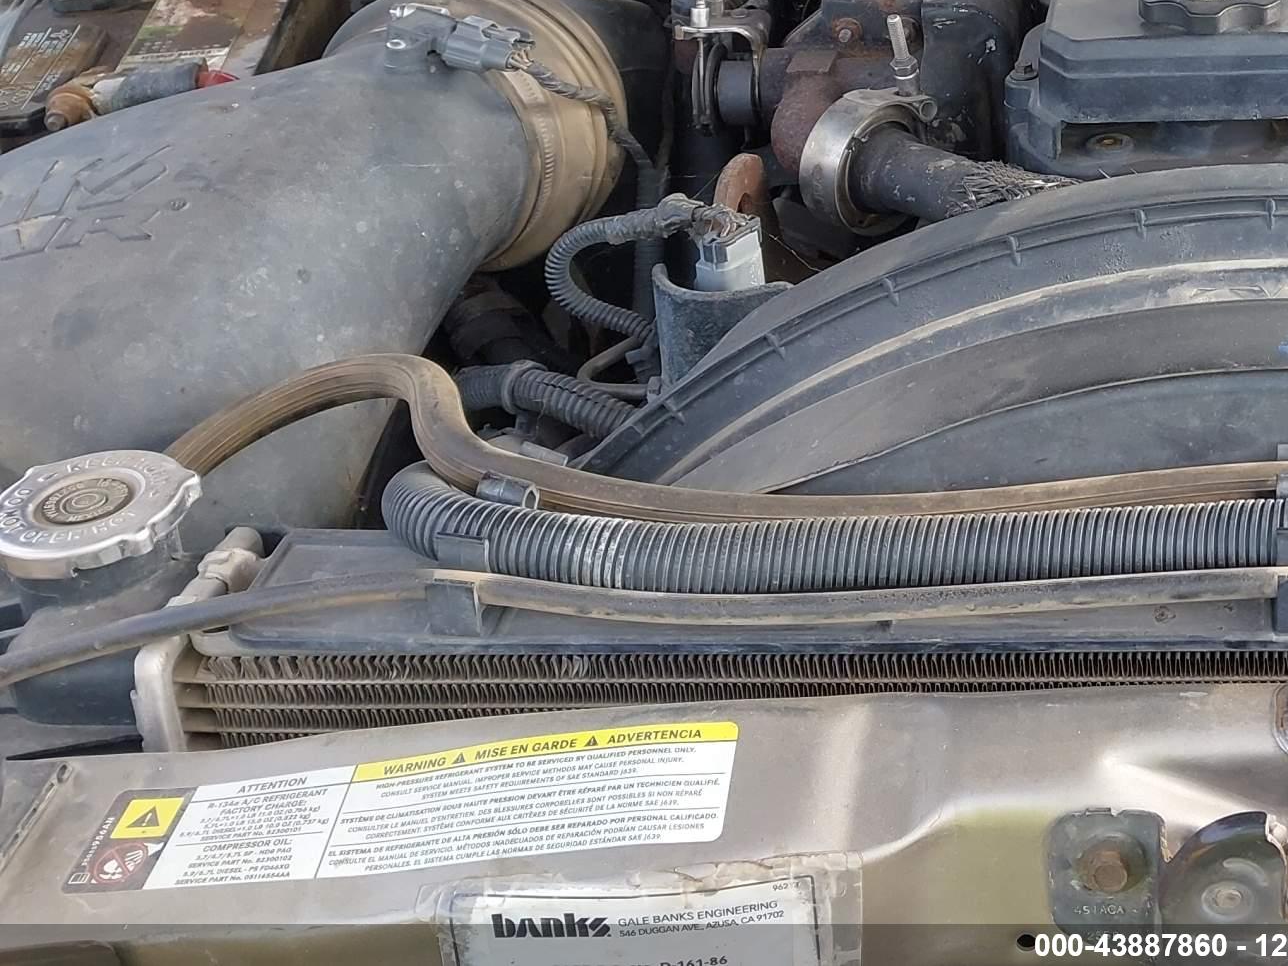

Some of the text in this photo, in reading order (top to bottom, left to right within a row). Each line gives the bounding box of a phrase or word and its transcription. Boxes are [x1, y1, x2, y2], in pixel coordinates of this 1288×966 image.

[607, 729, 700, 743] ADVERTENCIA
[474, 738, 576, 759] MISE EN GARDE
[376, 775, 433, 789] HIGH-PRESSURE
[434, 767, 483, 780] REFRIGERANT
[484, 762, 513, 772] SYSTEM
[537, 756, 574, 765] SERVICED
[586, 750, 626, 760] QUALIFIED
[627, 747, 671, 756] PERSONNEL
[384, 757, 446, 774] WARNING
[237, 777, 307, 793] ATTENTION
[380, 787, 412, 798] CONSULT
[413, 782, 442, 793] SERVICE
[442, 778, 472, 788] MANUAL.
[474, 772, 510, 783] IMPROPER
[511, 769, 540, 778] SERVICE
[542, 765, 576, 774] METHODS
[594, 760, 617, 769] CAUSE
[618, 758, 654, 766] PERSONAL
[421, 790, 447, 800] SYSTEM
[449, 786, 471, 795] MEETS
[473, 782, 499, 791] SAFETY
[500, 776, 554, 787] REQUIREMENTS
[582, 769, 618, 778] STANDARD
[240, 796, 260, 805] A/C
[262, 788, 327, 802] REFRIGERANT
[219, 799, 306, 815] FACTORY CHARGE:
[202, 839, 271, 852] COMPRESSOR
[618, 916, 652, 928] GALE
[652, 910, 694, 925] BANKS
[697, 900, 778, 920] ENGINEERING
[619, 928, 636, 938] 546
[638, 924, 681, 936] DUGGAN
[740, 914, 756, 925] CA
[756, 910, 784, 922] 91702
